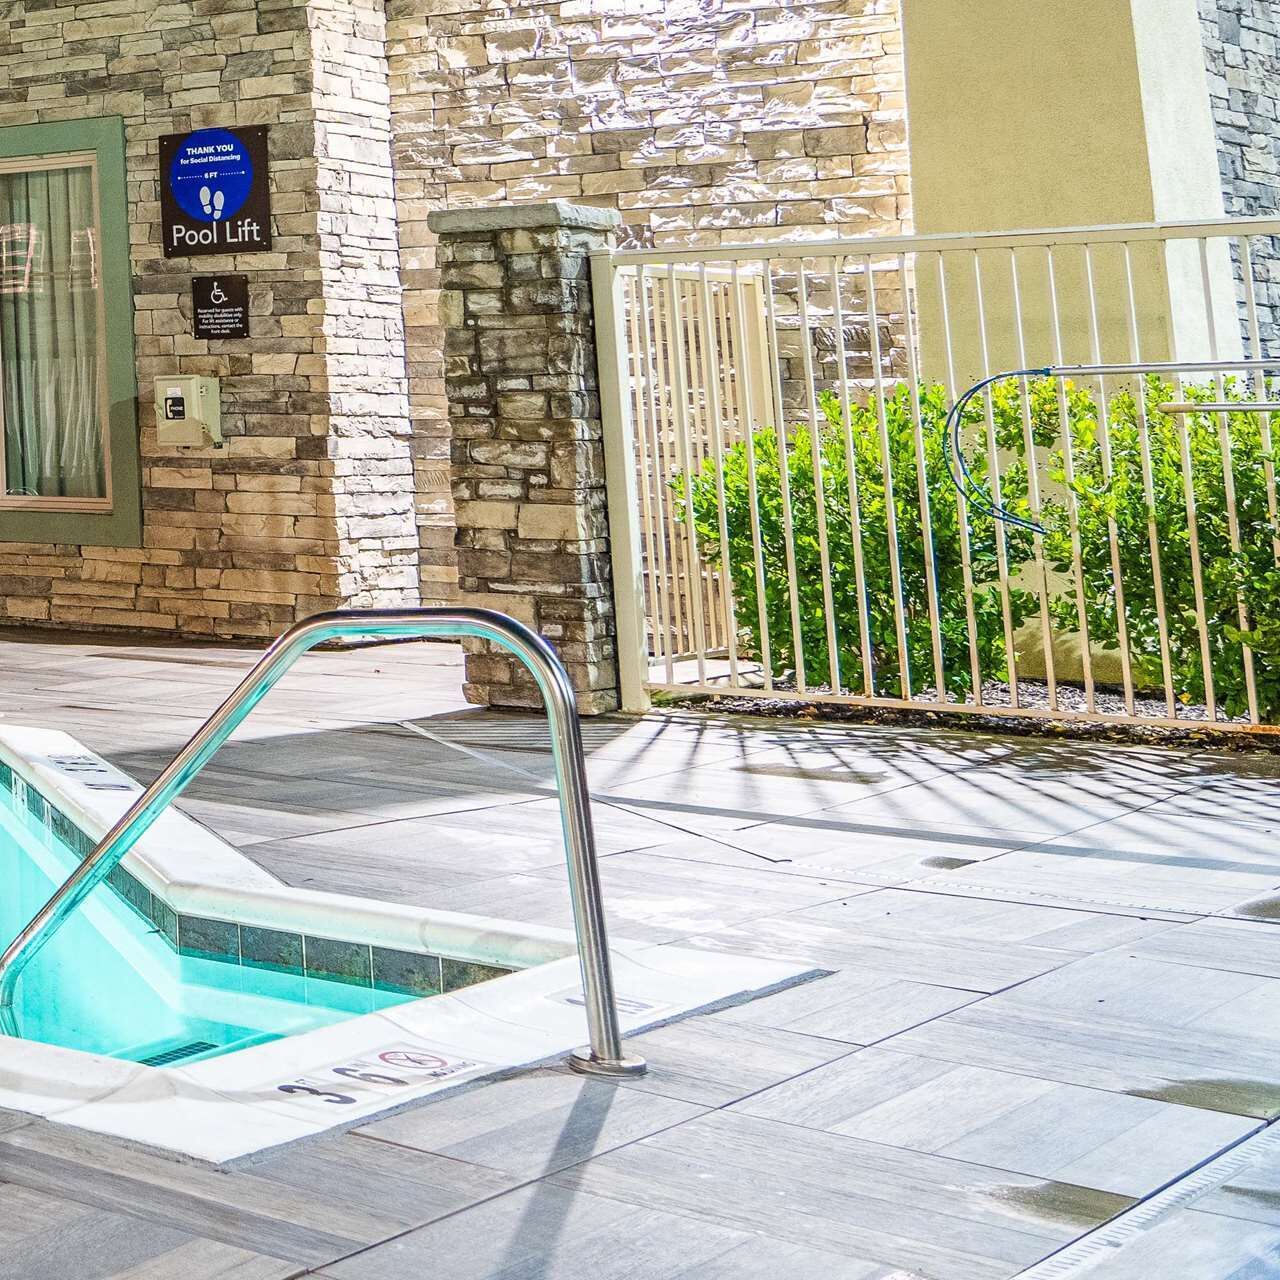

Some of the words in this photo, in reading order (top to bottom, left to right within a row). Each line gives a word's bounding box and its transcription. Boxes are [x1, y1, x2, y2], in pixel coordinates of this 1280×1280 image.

[186, 145, 215, 155] THANK
[216, 144, 234, 152] YOU
[190, 156, 208, 164] Social
[209, 154, 241, 162] Distancing
[172, 221, 217, 246] Pool
[225, 218, 261, 243] Lift
[277, 1084, 358, 1105] 3
